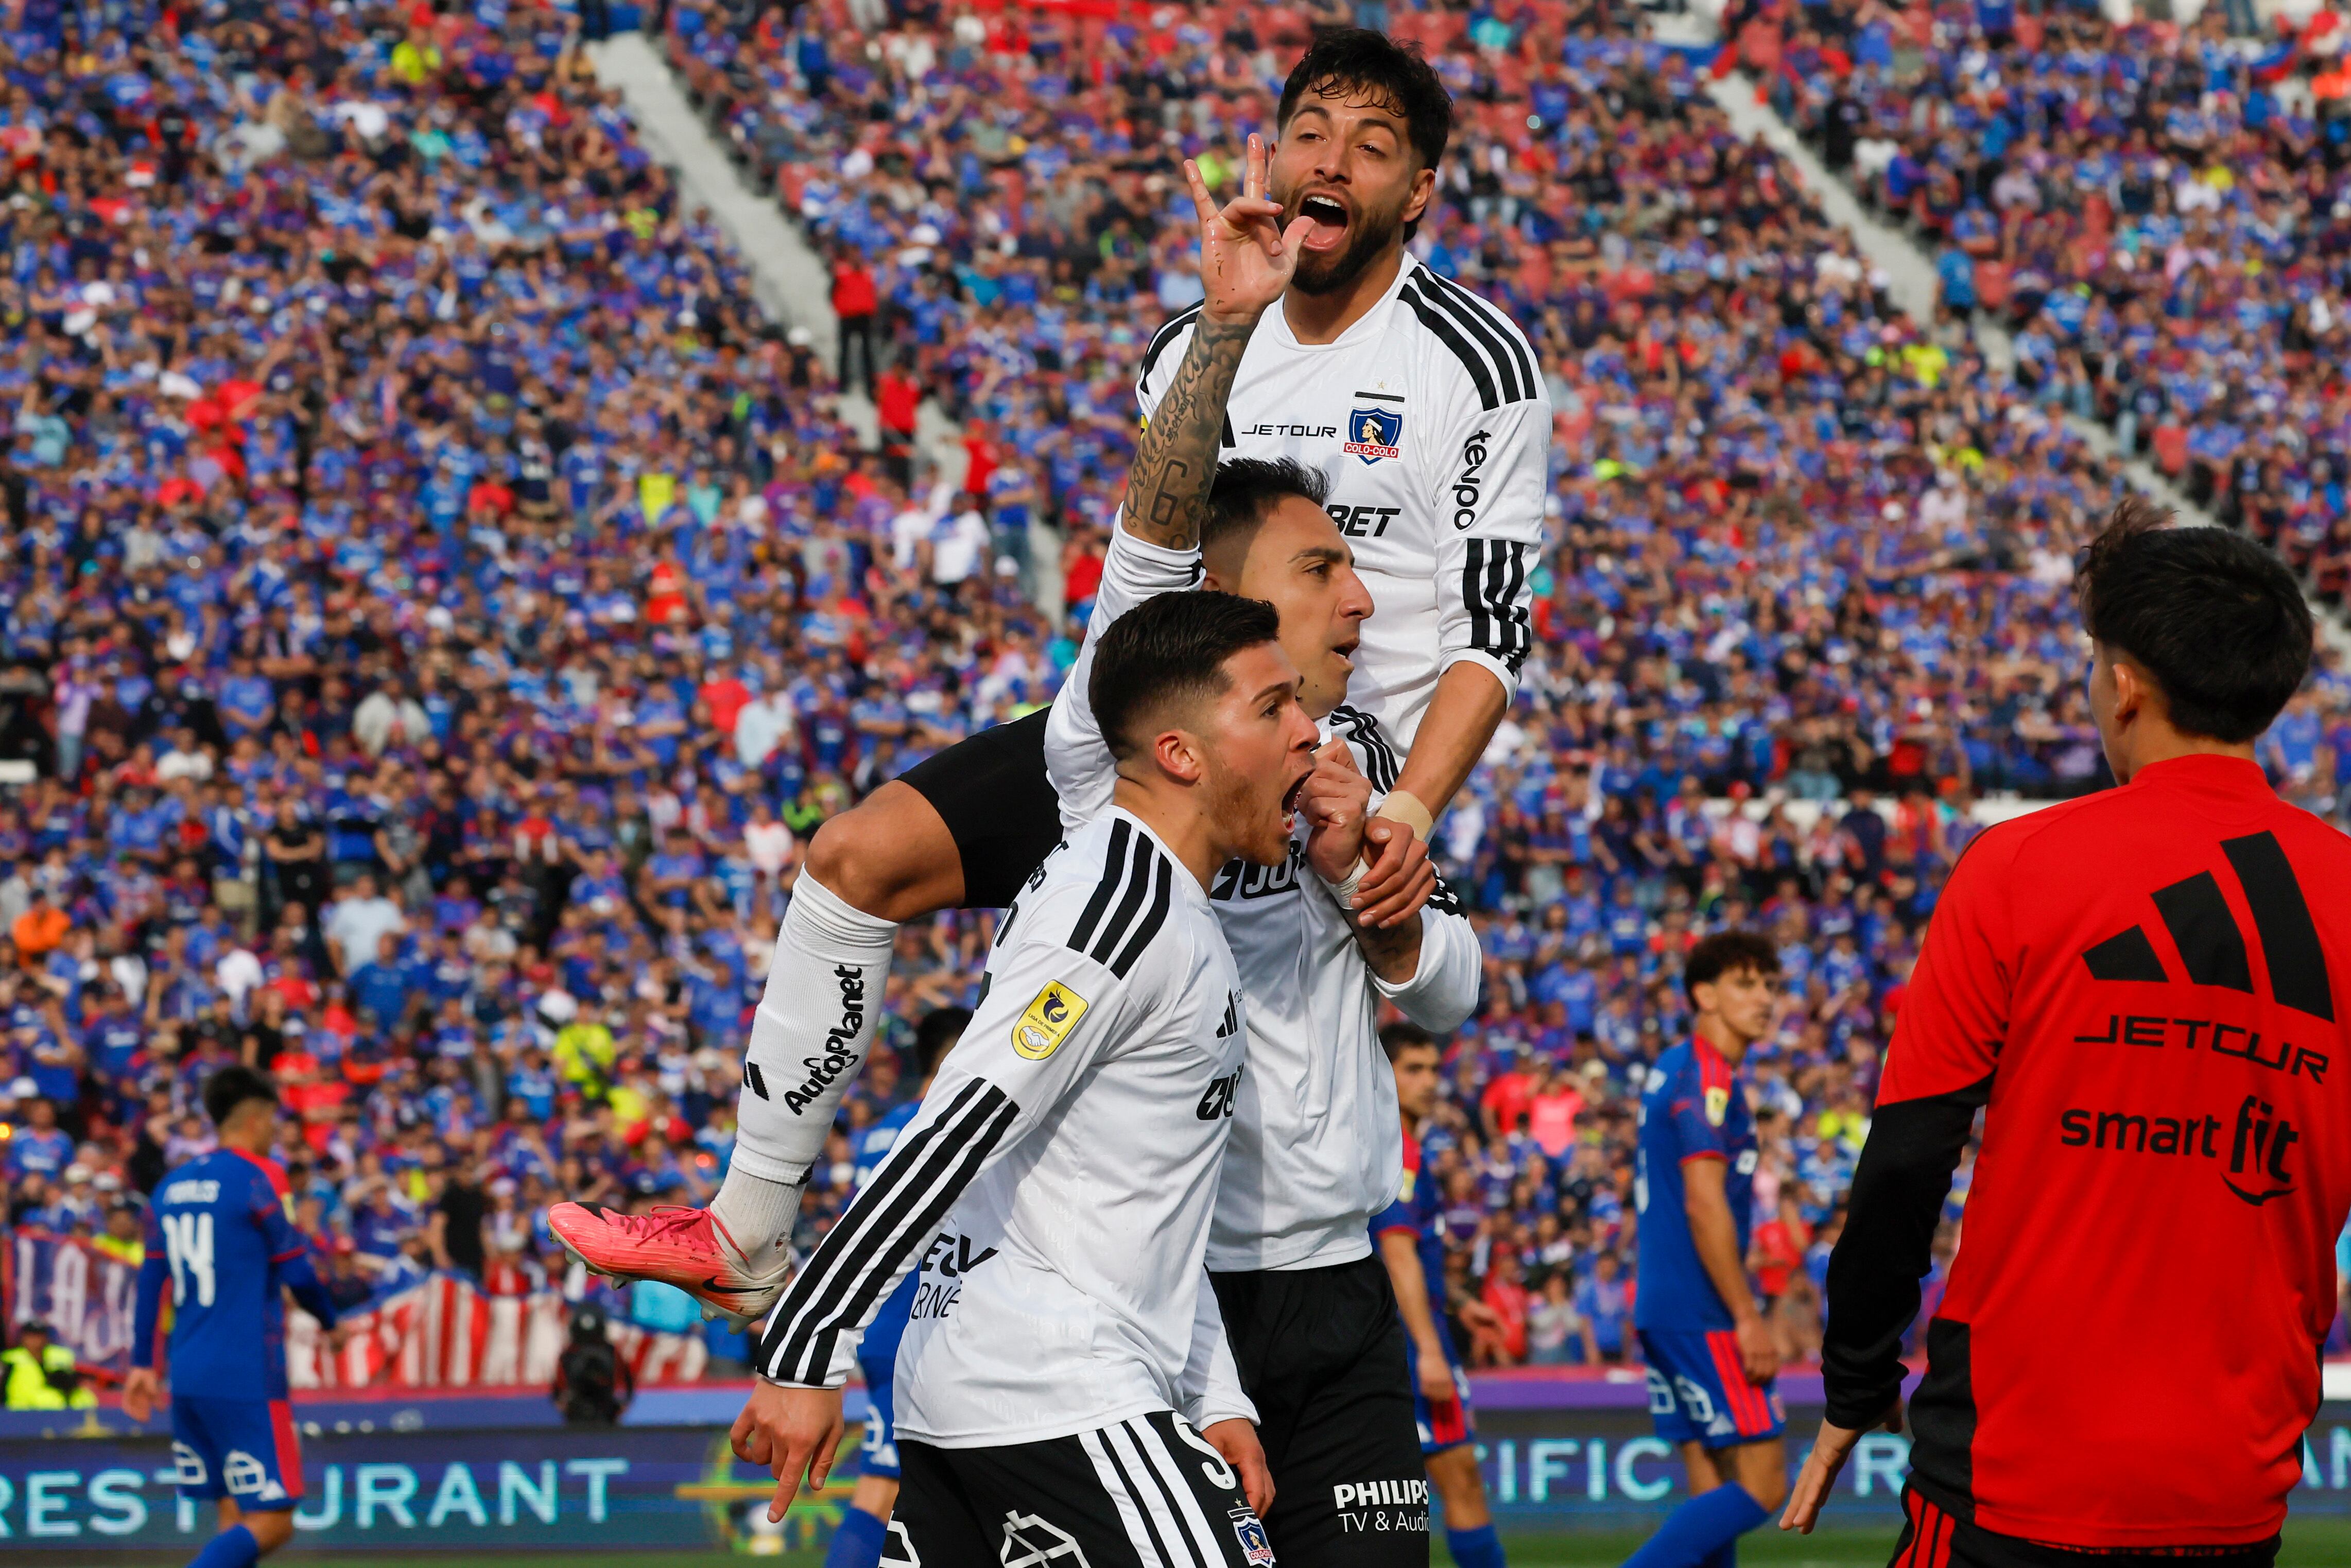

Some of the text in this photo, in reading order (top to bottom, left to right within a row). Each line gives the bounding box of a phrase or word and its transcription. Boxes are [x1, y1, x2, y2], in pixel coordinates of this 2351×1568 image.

[1241, 424, 1337, 438] JETOUR
[1345, 443, 1397, 457] COLO-COLO
[784, 964, 864, 1116] Autoplanet
[1028, 1013, 1038, 1022] LIGA
[1043, 1023, 1060, 1037] PRIMERA
[2074, 1014, 2329, 1084] JETOUR
[2061, 1095, 2299, 1183] smart fit
[161, 1211, 216, 1308] 14
[1333, 1479, 1429, 1509] PHILIPS
[1338, 1511, 1368, 1533] TV
[1375, 1511, 1390, 1531] &
